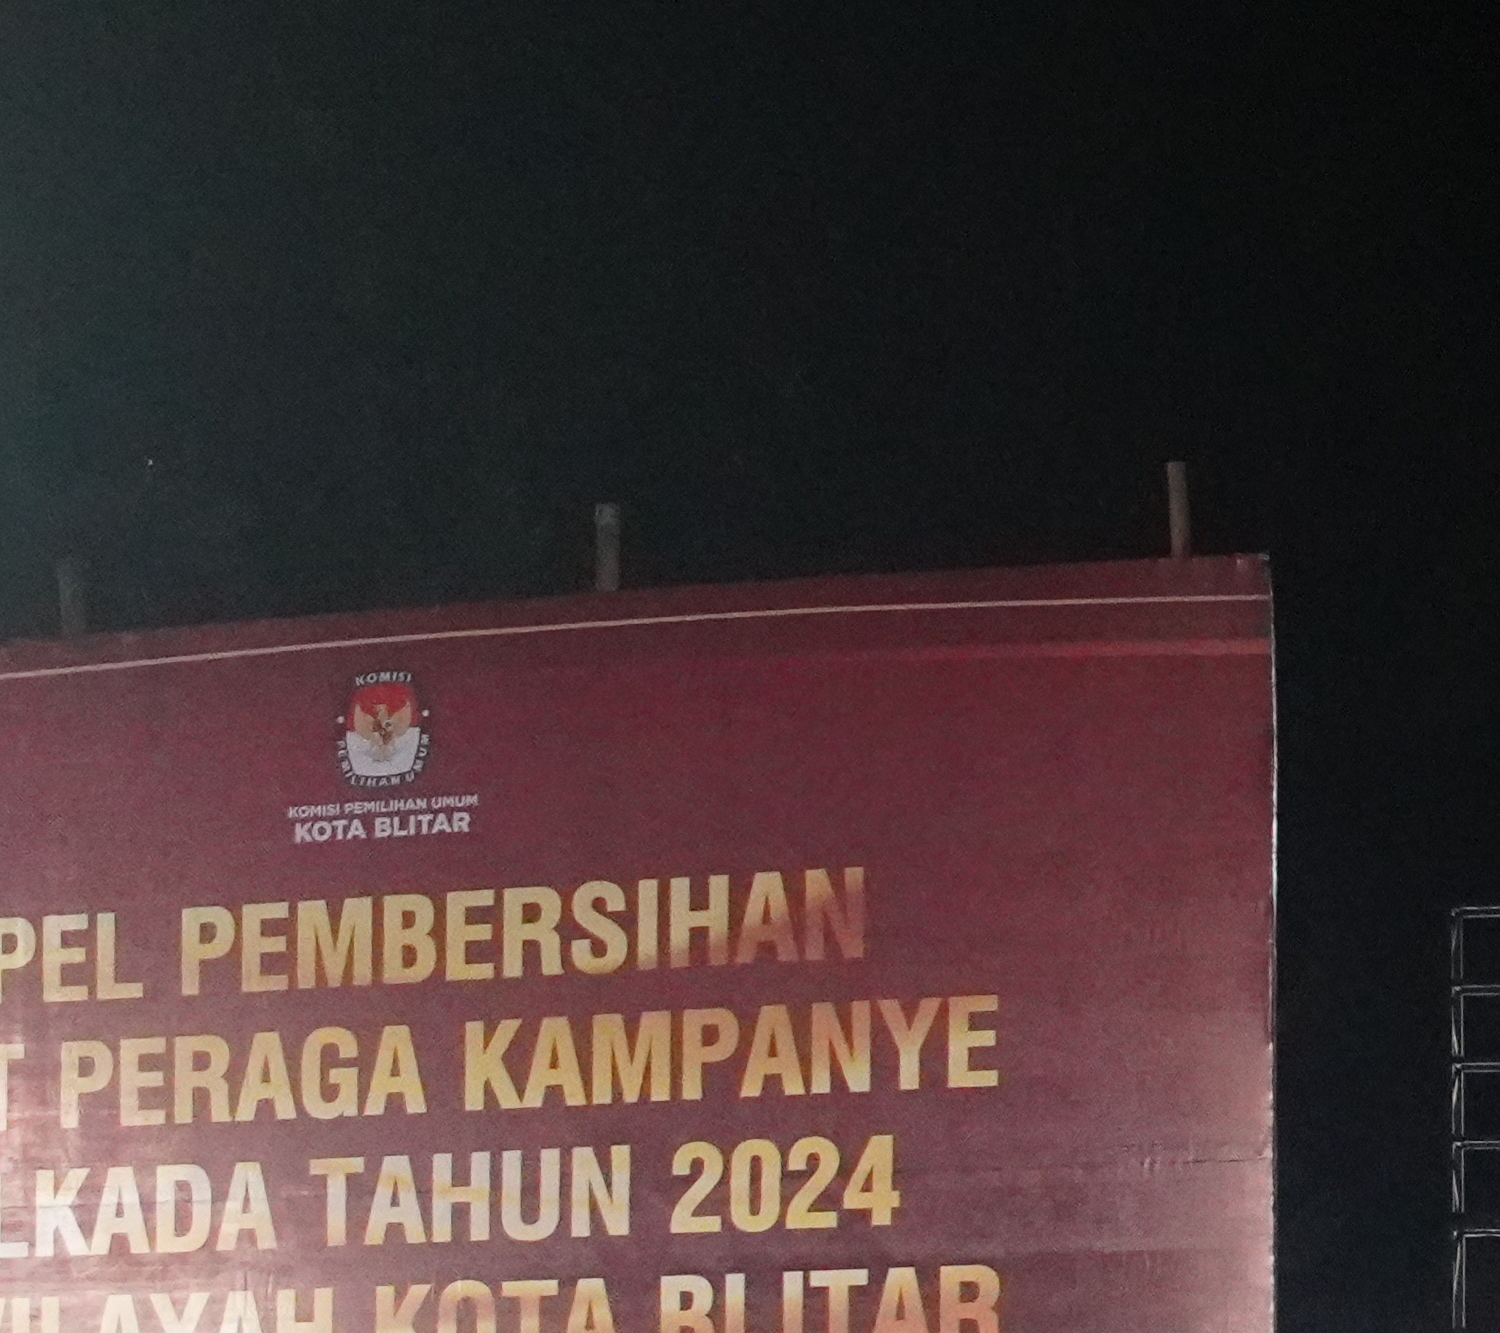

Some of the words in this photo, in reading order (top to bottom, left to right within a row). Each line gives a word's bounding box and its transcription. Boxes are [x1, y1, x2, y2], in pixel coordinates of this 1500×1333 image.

[288, 803, 340, 819] KOMISI
[344, 798, 427, 815] PEMILIHAN
[431, 794, 479, 810] UMUM
[294, 819, 367, 844] KOTA
[374, 811, 471, 839] BLITAR
[181, 866, 865, 996] PEMBERSIHAN
[60, 1025, 427, 1129] PERAGA
[464, 994, 999, 1112] KAMPANYE
[310, 1144, 631, 1247] TAHUN
[670, 1134, 900, 1235] 2024
